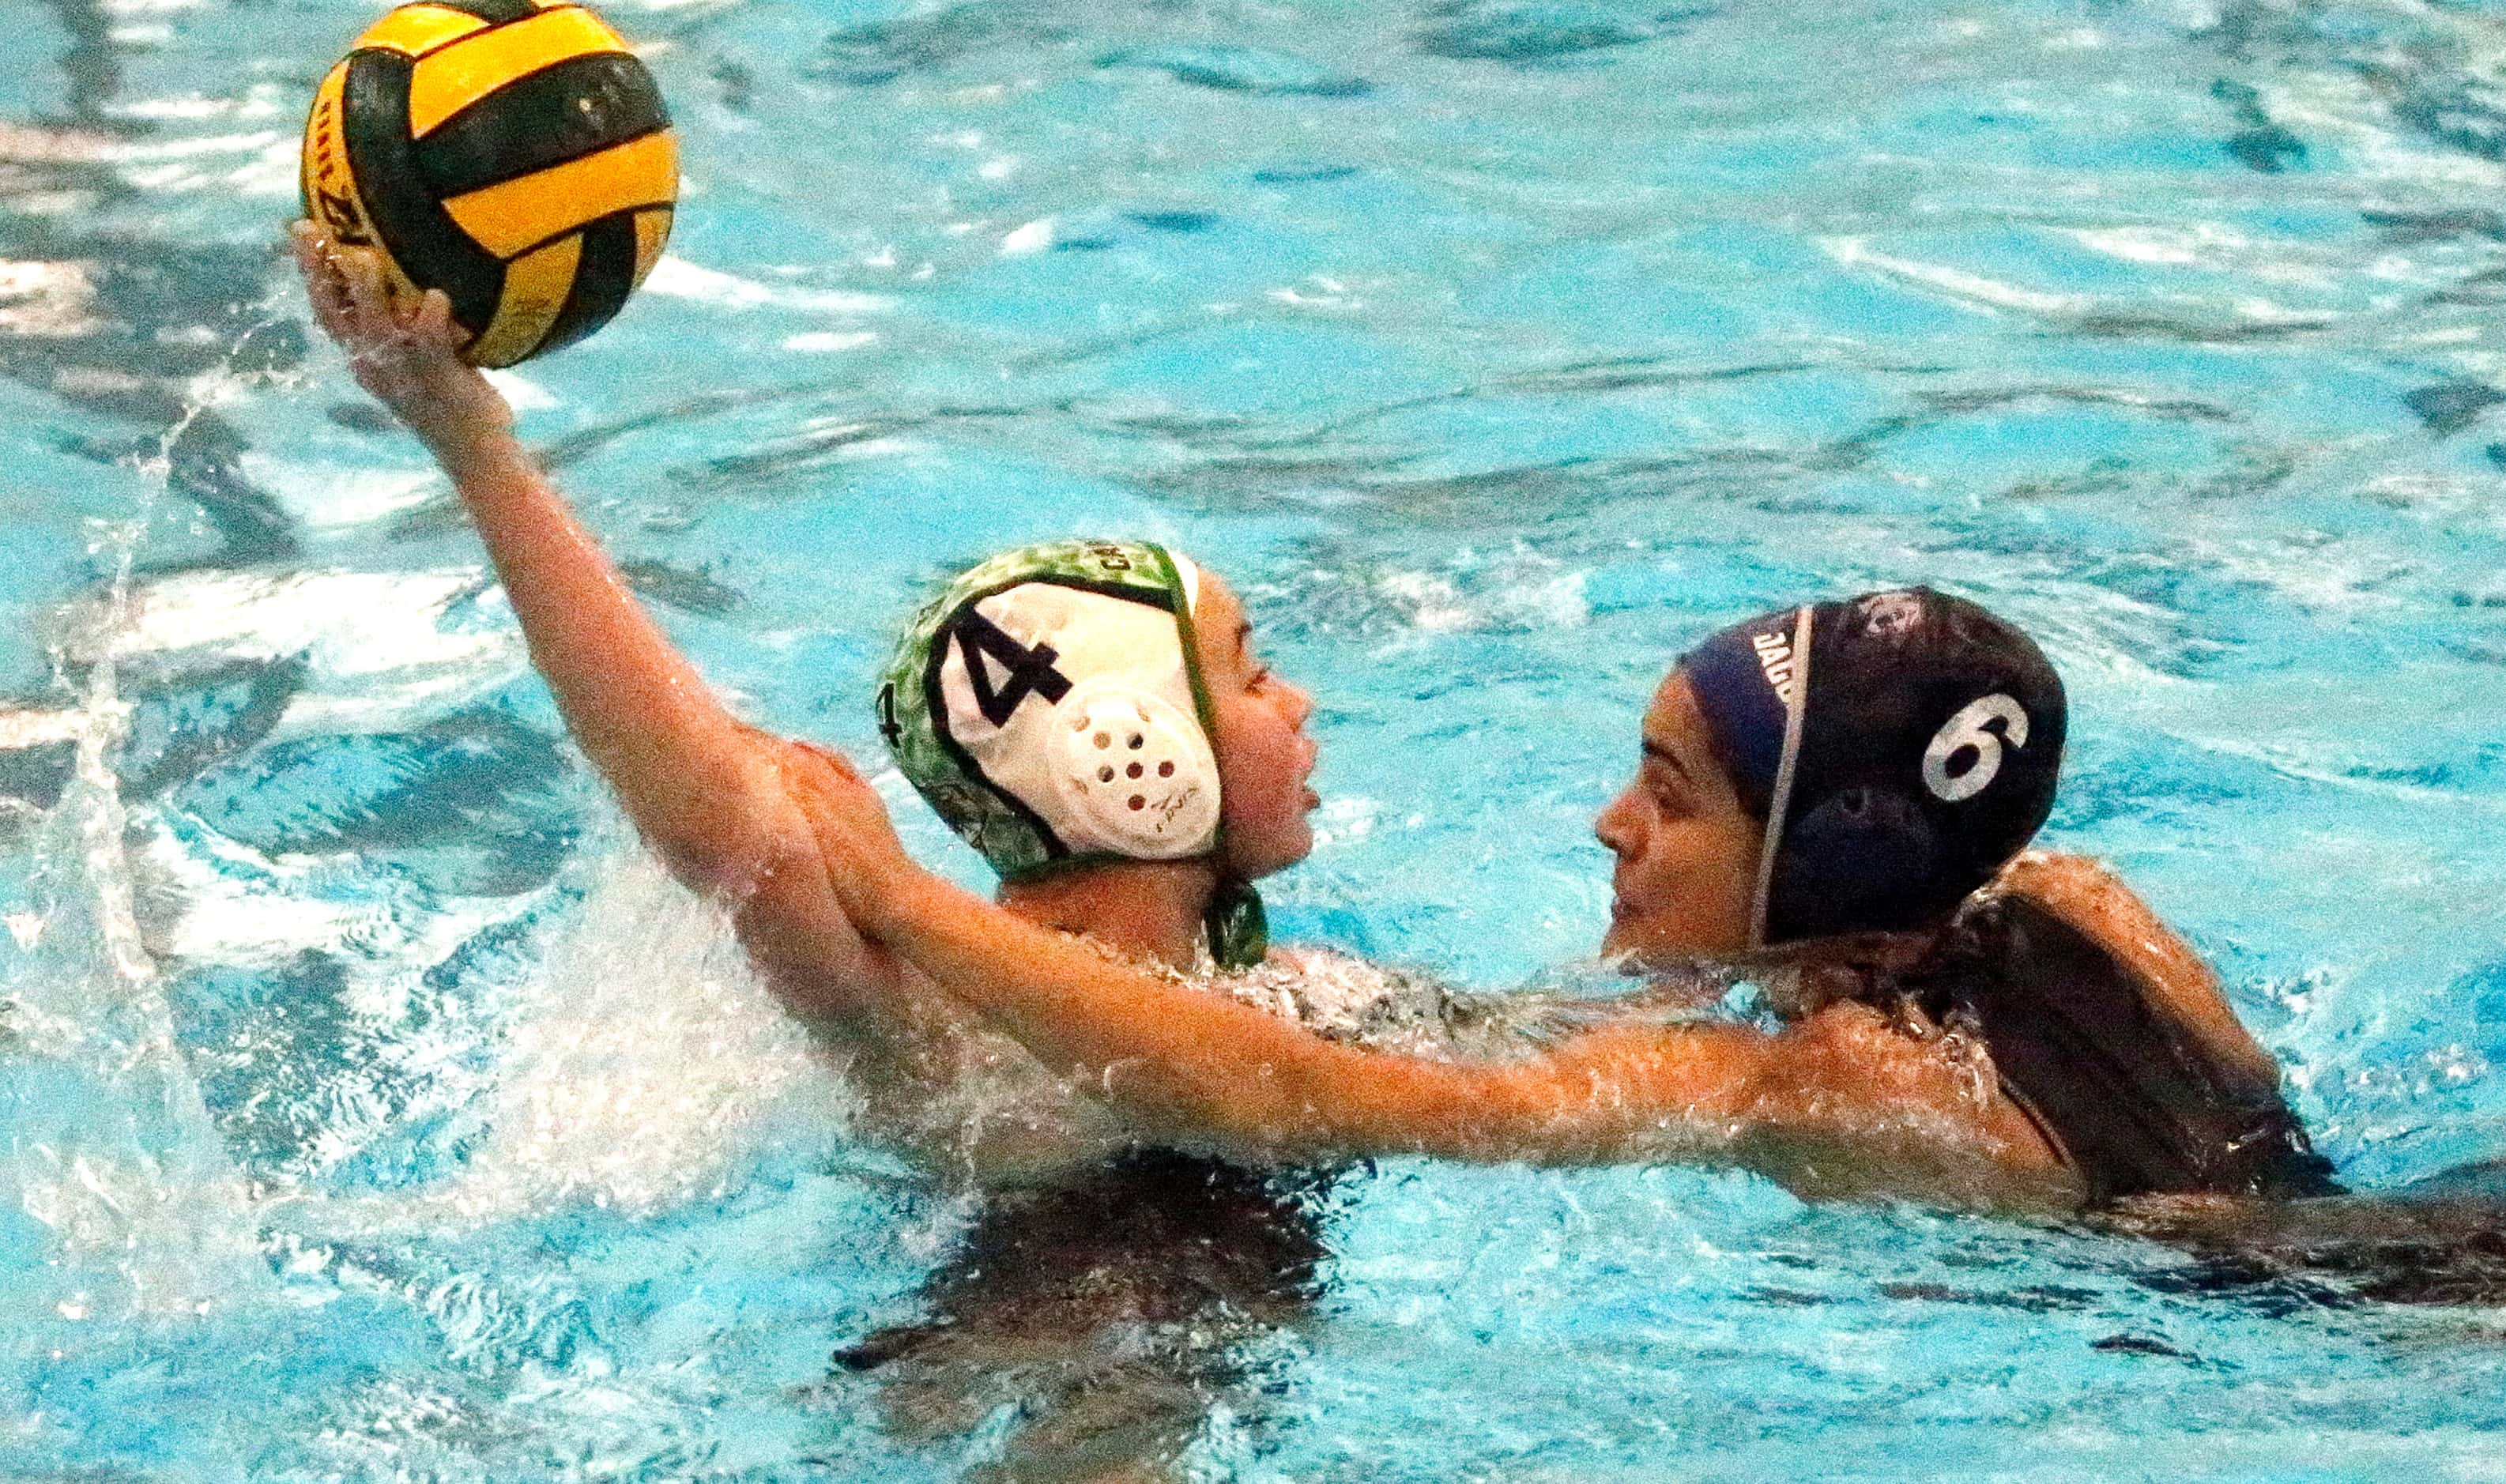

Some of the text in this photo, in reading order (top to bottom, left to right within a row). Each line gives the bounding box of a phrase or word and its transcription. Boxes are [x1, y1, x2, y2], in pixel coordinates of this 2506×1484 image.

[876, 683, 903, 749] 4
[951, 606, 1073, 729] 4
[1922, 693, 2029, 801] 6
